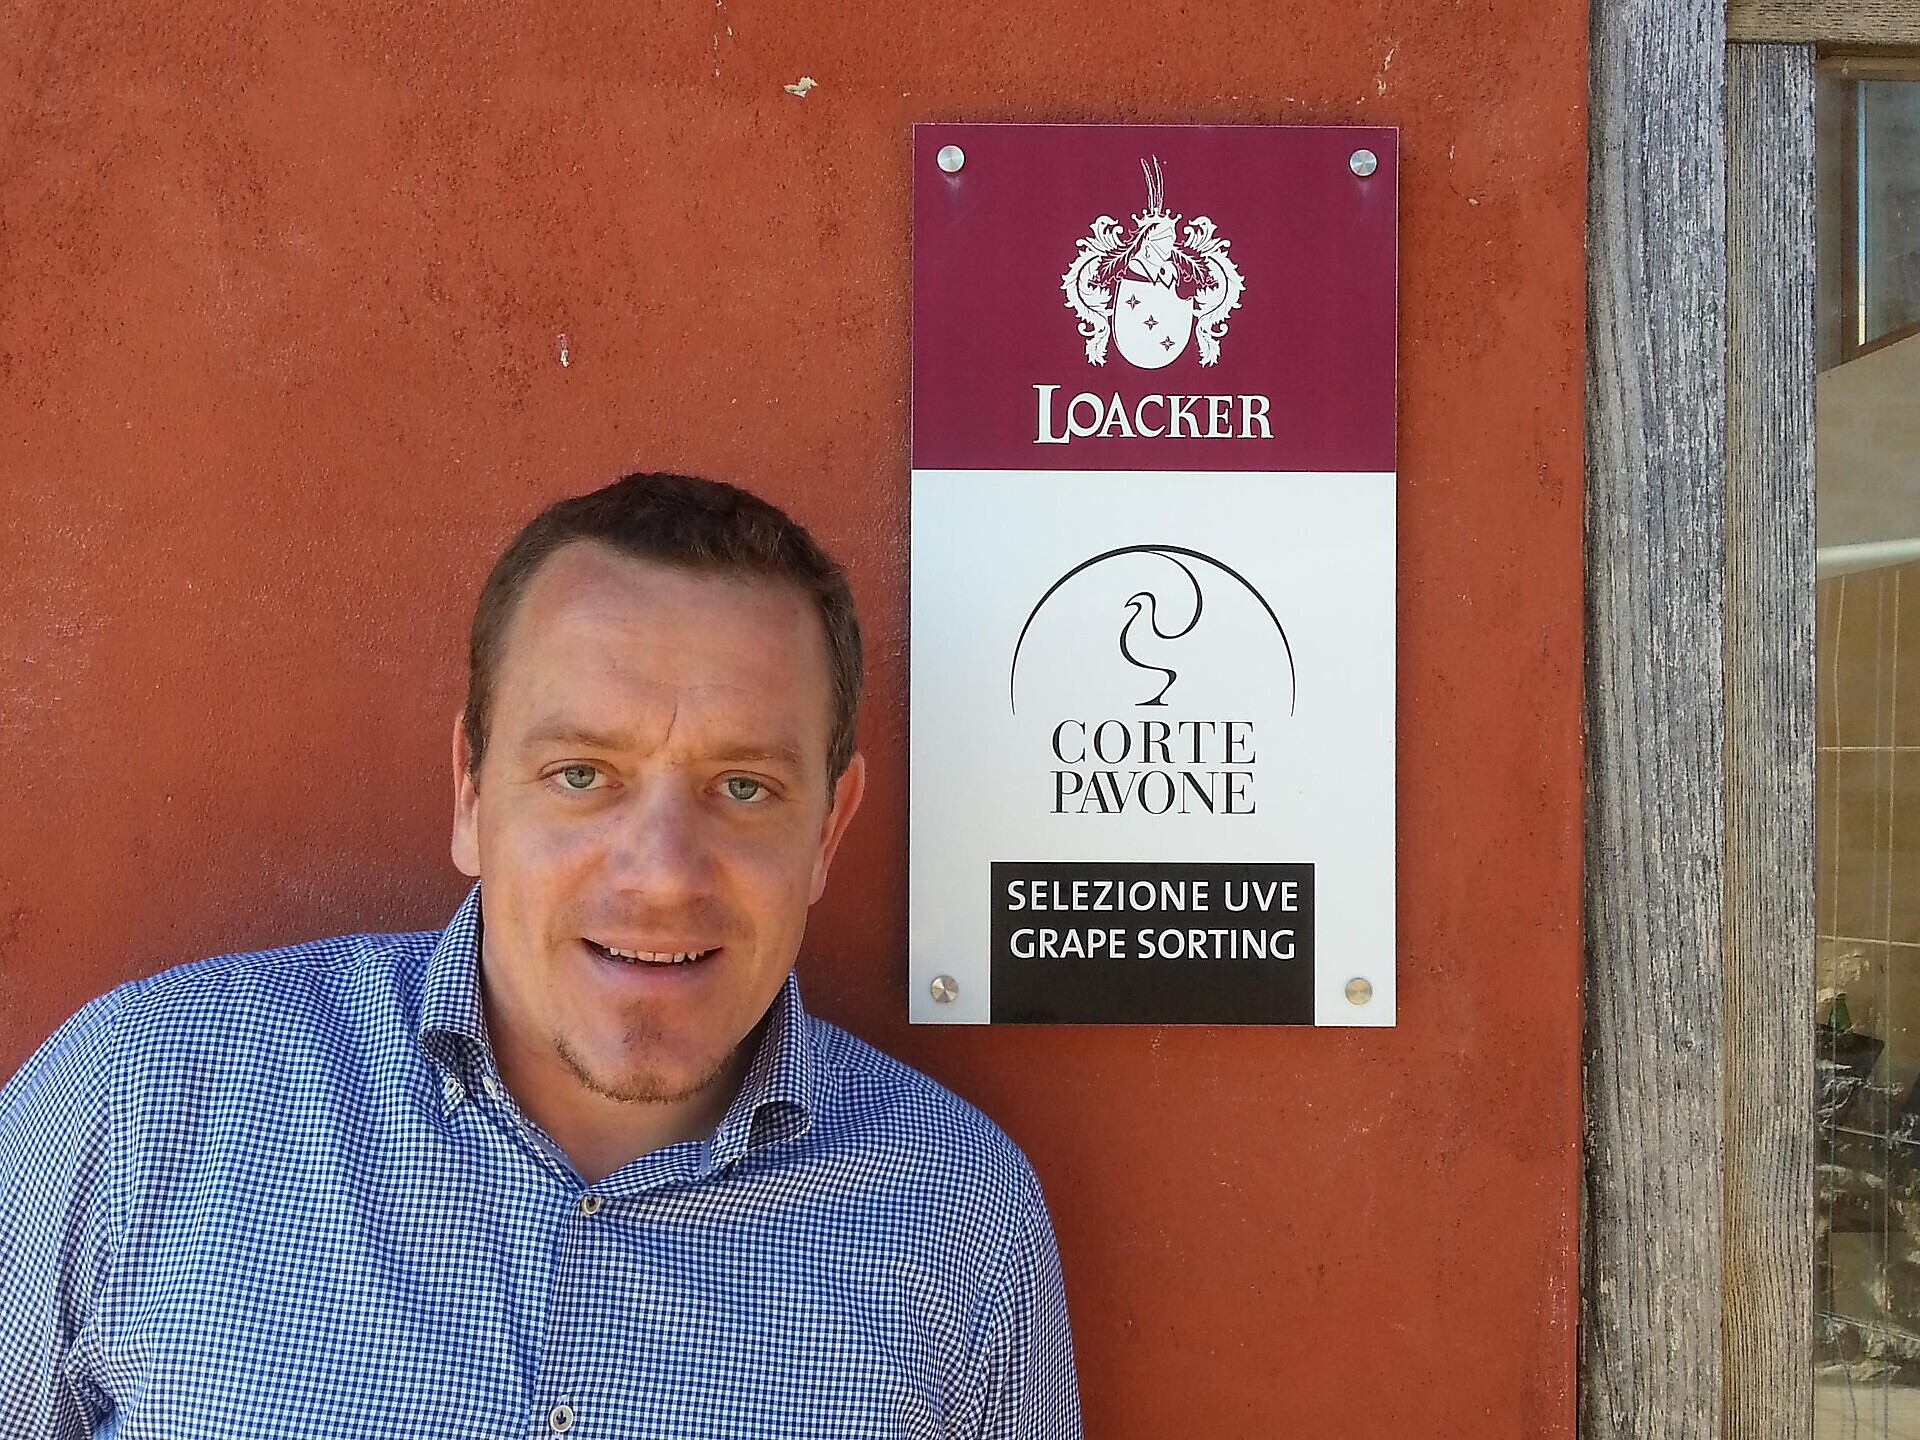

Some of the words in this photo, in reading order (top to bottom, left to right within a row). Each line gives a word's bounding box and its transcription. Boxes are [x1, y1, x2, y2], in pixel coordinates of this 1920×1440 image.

[1032, 384, 1275, 444] LOACKER
[1052, 719, 1256, 765] CORTE
[1050, 770, 1256, 815] PAVONE
[1007, 880, 1209, 912] SELEZIONE
[1225, 881, 1299, 912] UVE
[1010, 928, 1126, 959] GRAPE
[1137, 928, 1296, 960] SORTING
